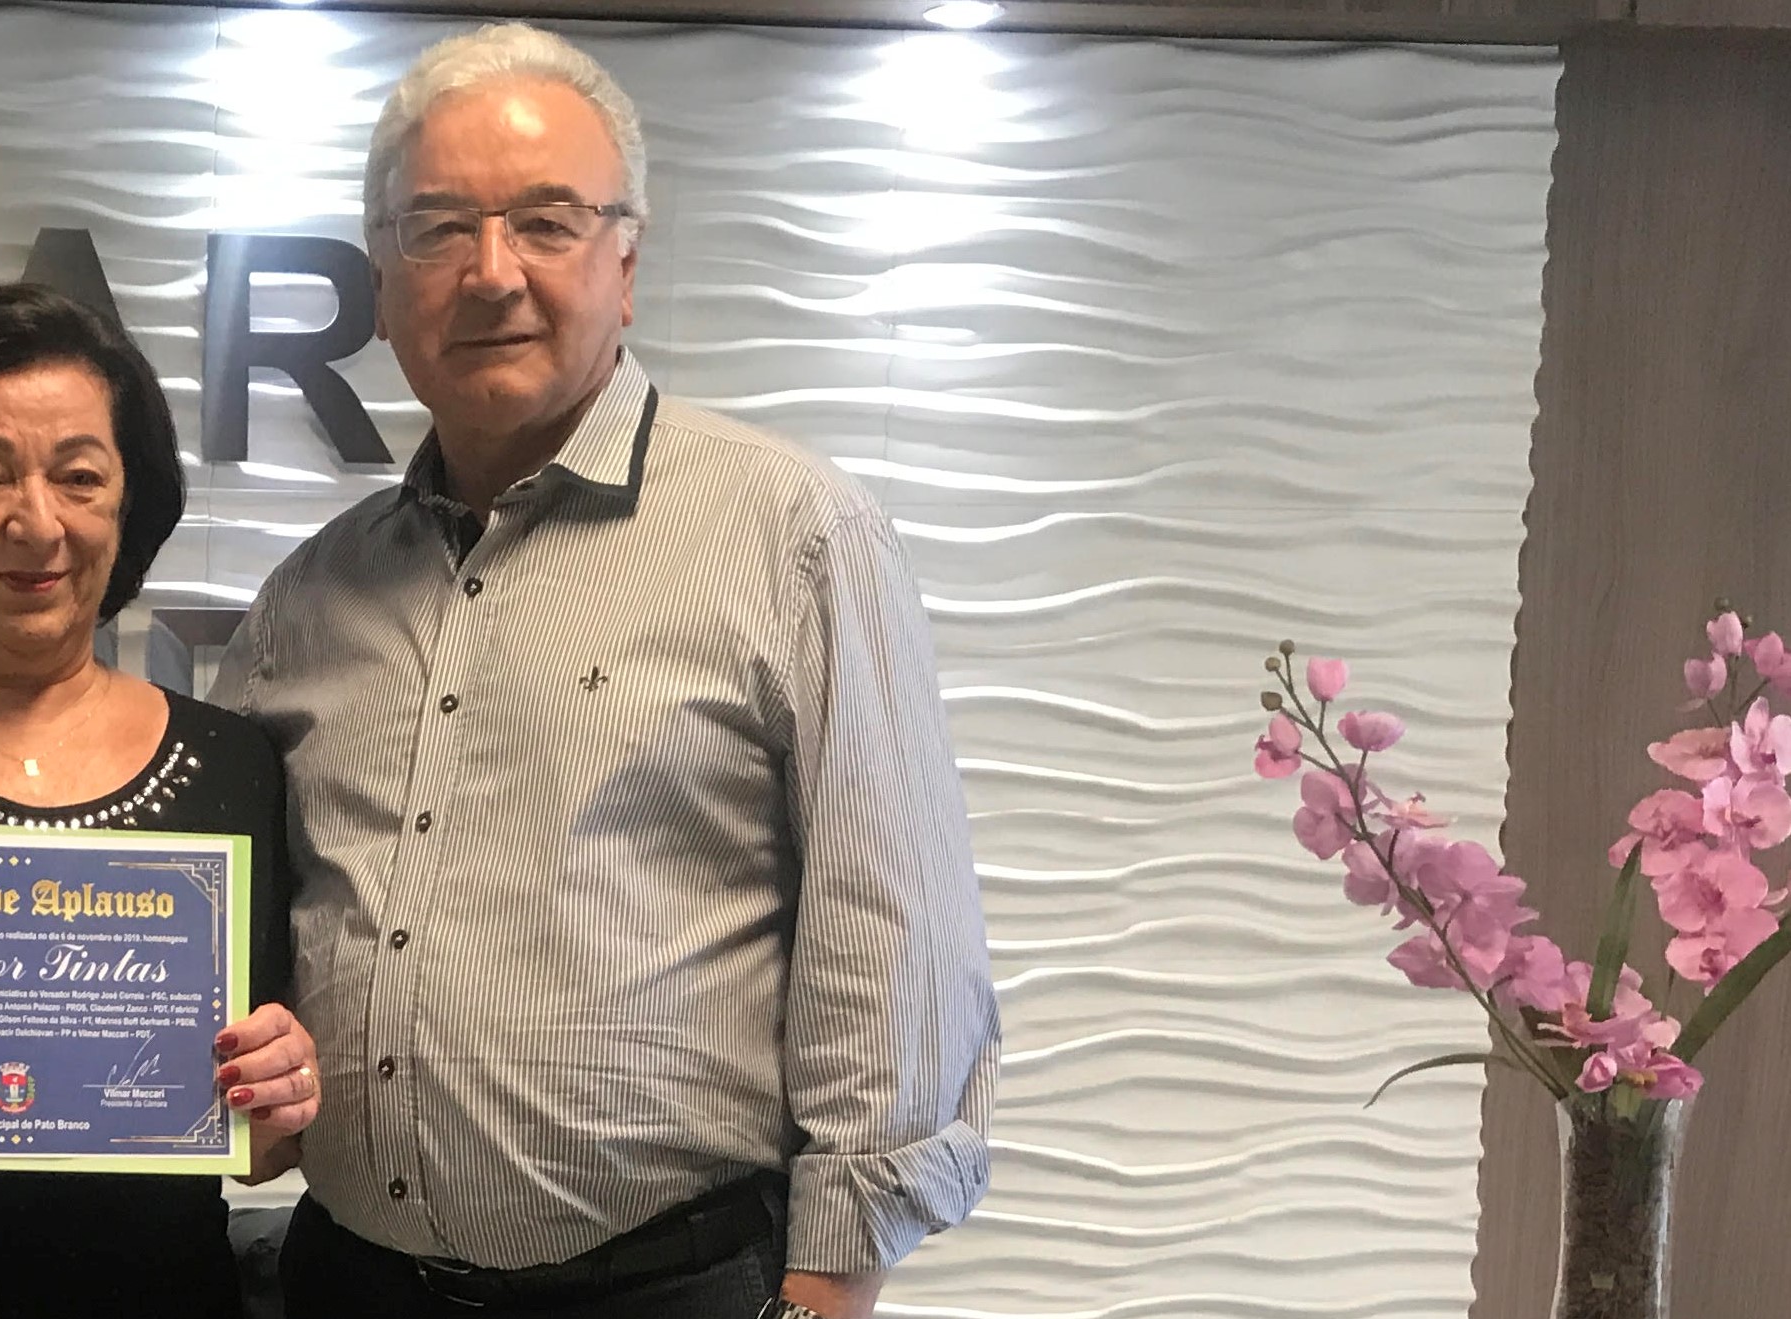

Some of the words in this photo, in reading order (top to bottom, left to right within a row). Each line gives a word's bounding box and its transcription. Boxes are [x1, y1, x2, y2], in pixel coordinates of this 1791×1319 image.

[31, 879, 175, 922] Aplauso
[39, 943, 170, 983] Tintas
[21, 1119, 33, 1130] de
[34, 1119, 56, 1130] Pato
[57, 1119, 91, 1130] Branco
